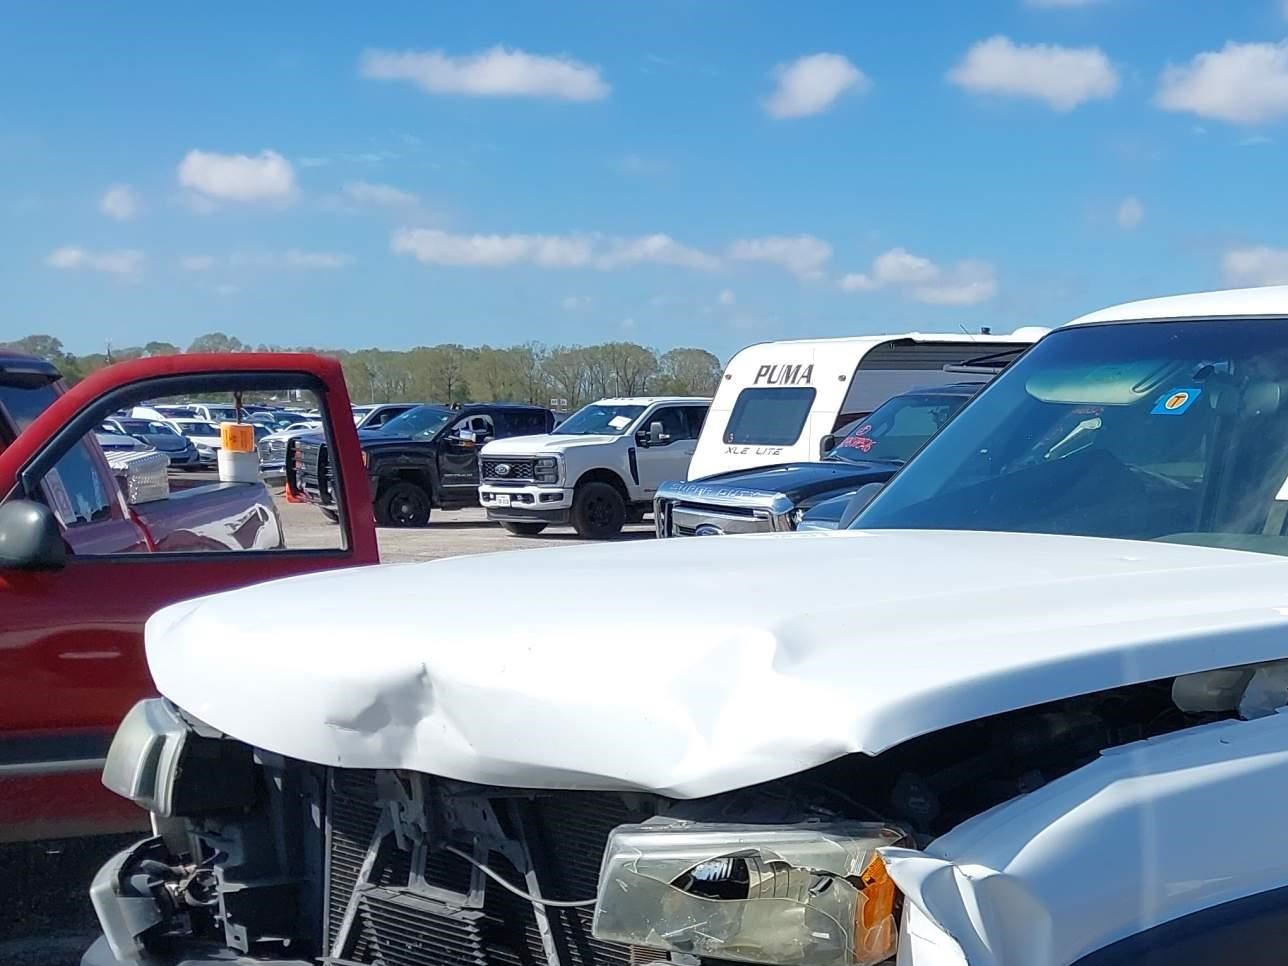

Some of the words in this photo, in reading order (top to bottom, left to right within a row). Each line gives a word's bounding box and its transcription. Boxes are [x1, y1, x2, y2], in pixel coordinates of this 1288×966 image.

[753, 364, 815, 385] PUMA
[725, 446, 750, 455] XLE
[755, 447, 784, 456] LITE
